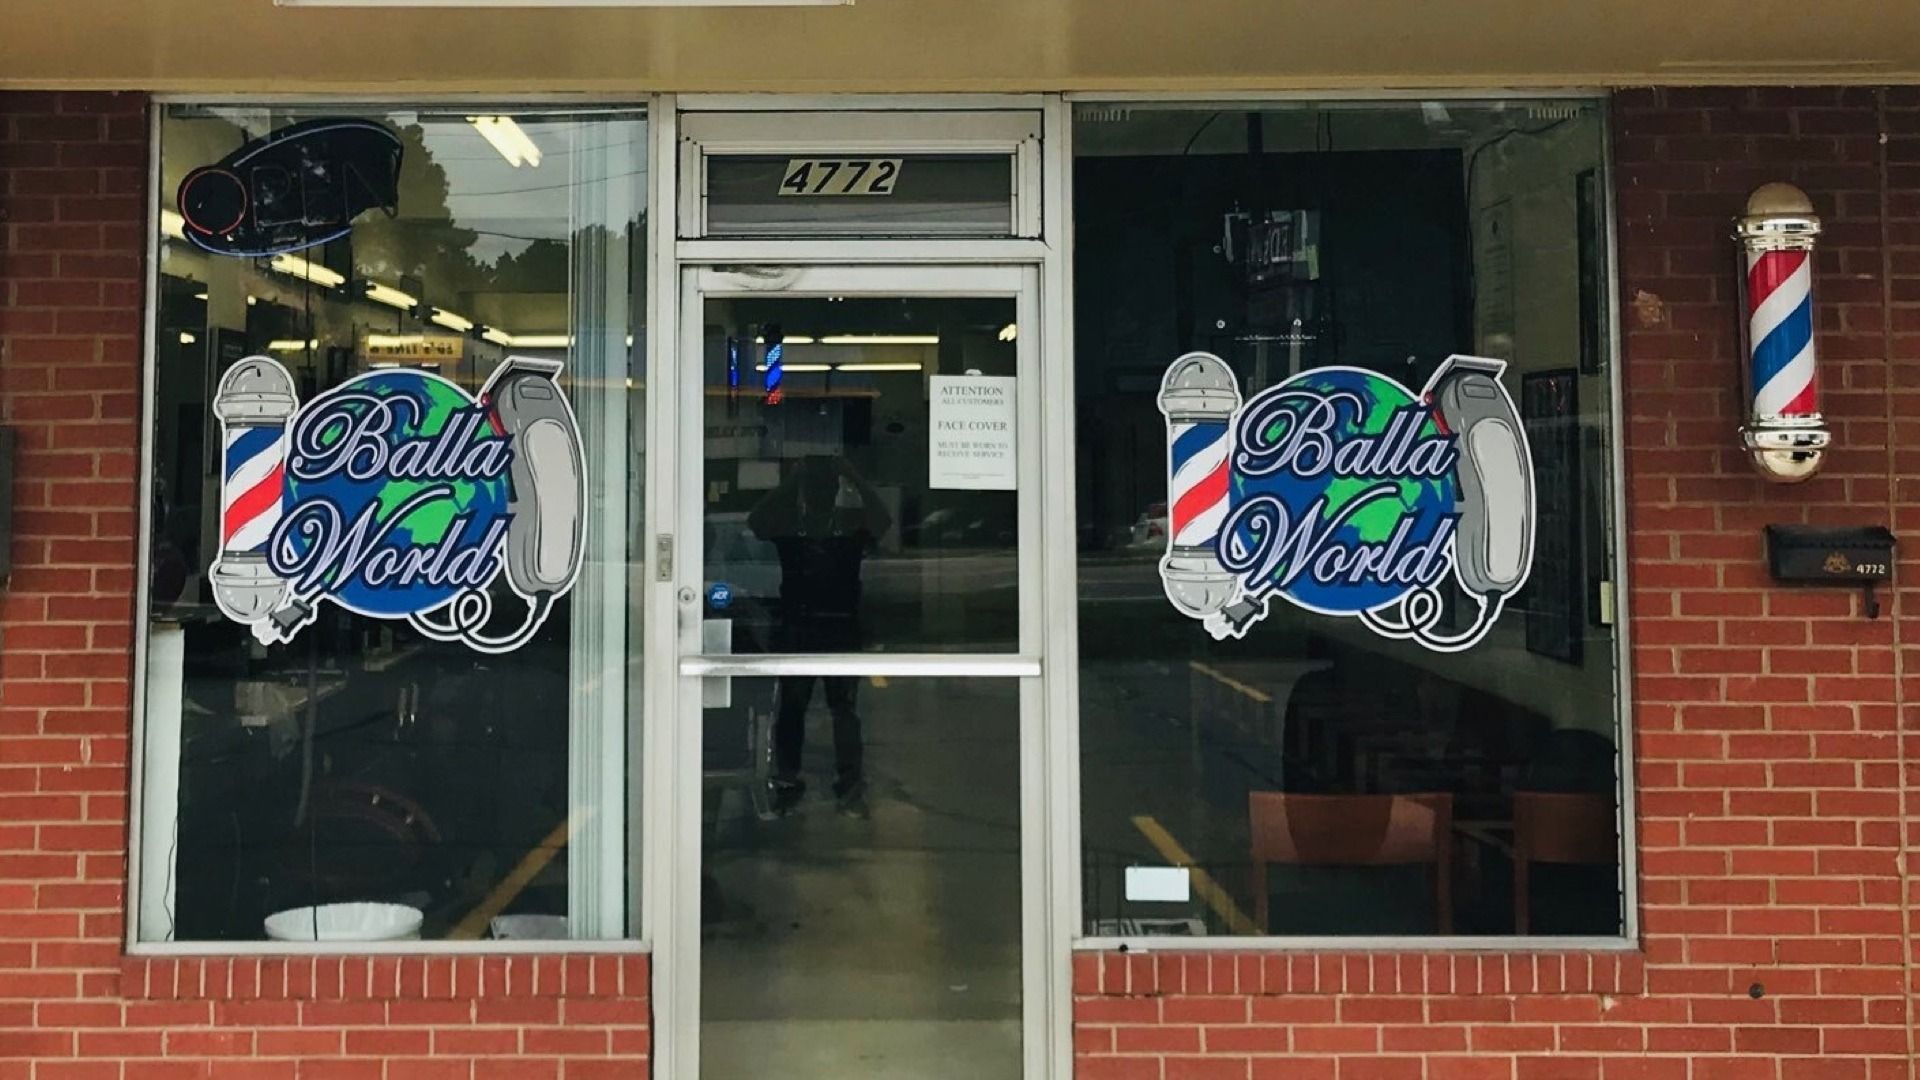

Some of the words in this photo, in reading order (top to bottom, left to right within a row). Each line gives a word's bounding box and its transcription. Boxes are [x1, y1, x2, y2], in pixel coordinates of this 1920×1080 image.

[783, 160, 896, 193] 4772
[940, 386, 1003, 396] ATTENTION
[292, 394, 510, 480] Balla
[937, 421, 965, 430] FACE
[968, 421, 1008, 431] COVER
[1236, 391, 1456, 477] Balla
[270, 485, 506, 591] World
[1218, 484, 1455, 587] World
[1857, 564, 1885, 574] 4772
